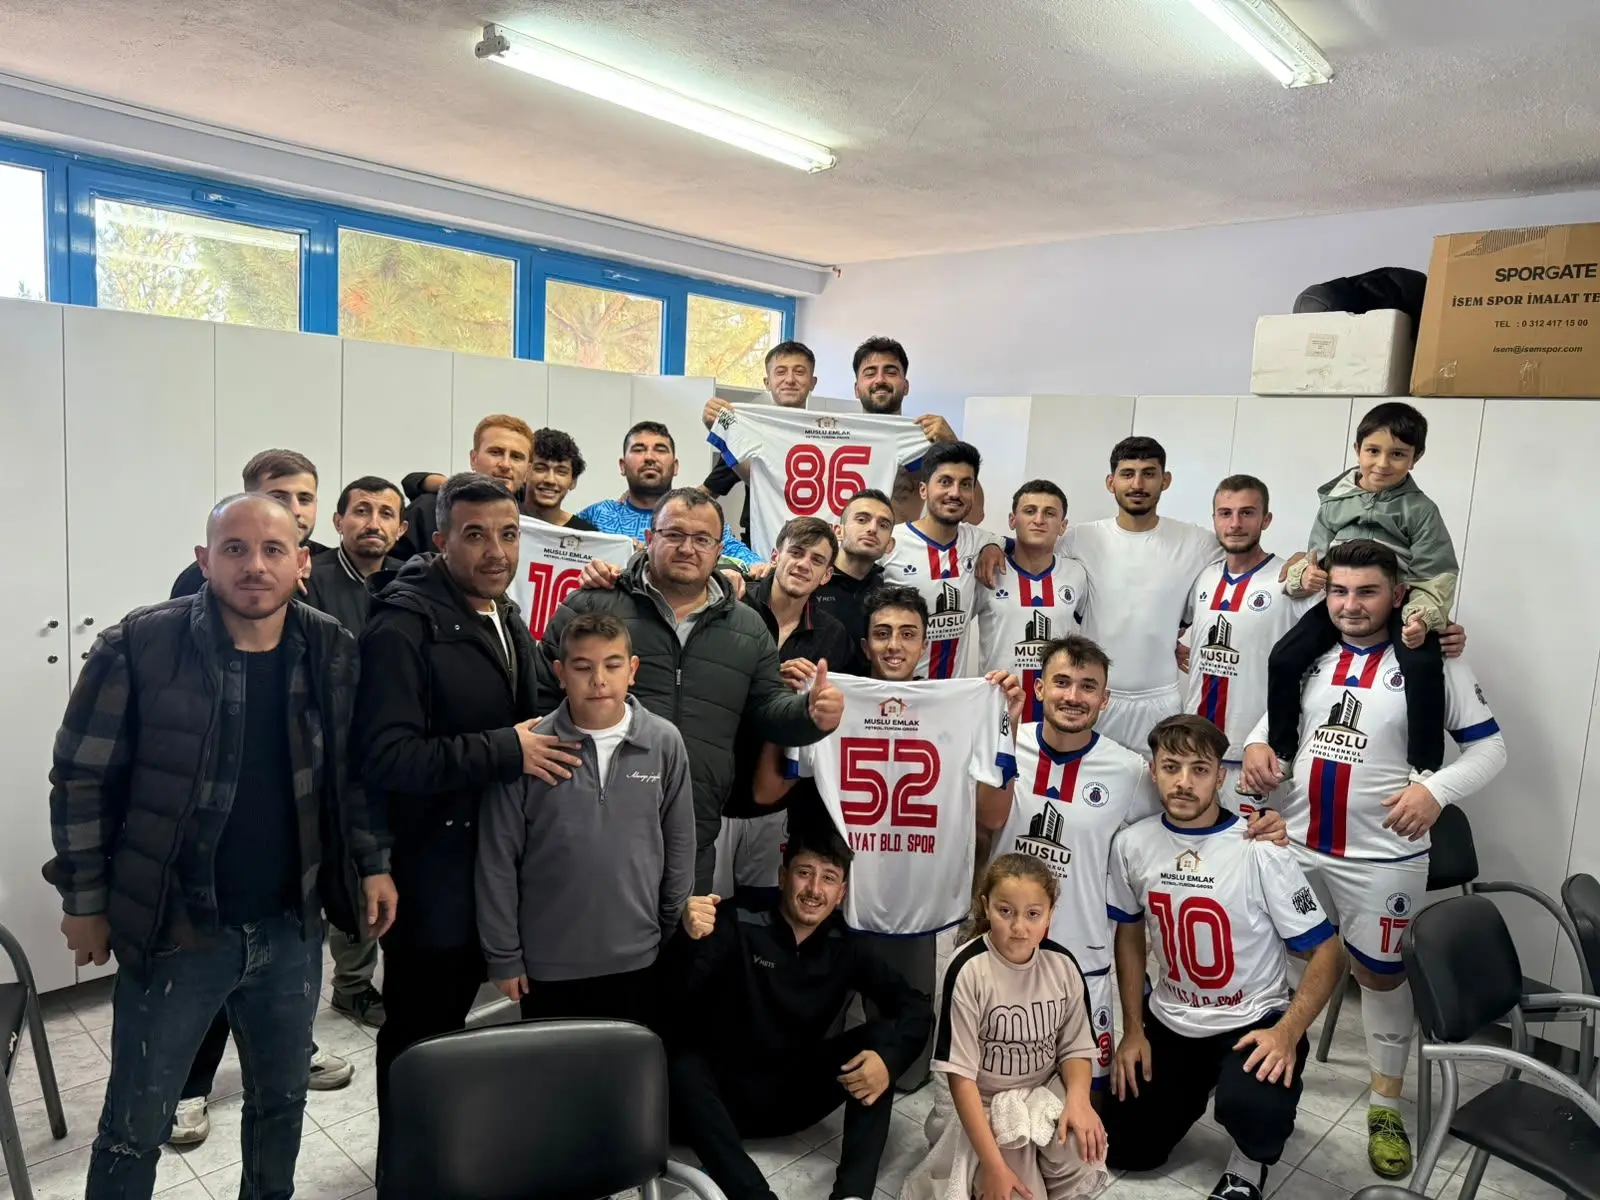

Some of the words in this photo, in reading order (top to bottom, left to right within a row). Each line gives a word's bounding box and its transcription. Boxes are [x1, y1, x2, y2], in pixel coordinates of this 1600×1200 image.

[1495, 263, 1598, 283] SPORGATE
[1452, 295, 1483, 307] İSEM
[1487, 295, 1523, 306] SPOR
[1527, 292, 1580, 305] İMALAT
[1495, 320, 1511, 328] TEL
[1529, 319, 1545, 328] 312
[1546, 319, 1562, 327] 417
[1565, 319, 1575, 327] 15
[1577, 319, 1589, 327] 00
[784, 444, 872, 516] 86
[543, 547, 568, 556] MUSLU
[569, 551, 593, 560] EMLAK
[927, 615, 965, 629] MUSLU
[1014, 645, 1043, 657] MUS
[1200, 649, 1240, 665] MUSLU
[1314, 729, 1368, 750] MUSLU
[840, 737, 941, 828] 52
[848, 832, 876, 852] AYAT
[907, 833, 936, 854] SPOR
[1015, 838, 1072, 865] MUSLU
[1160, 872, 1185, 881] MUSLU
[1187, 875, 1214, 884] EMLAK
[1148, 891, 1234, 989] 10
[1379, 917, 1410, 954] 17
